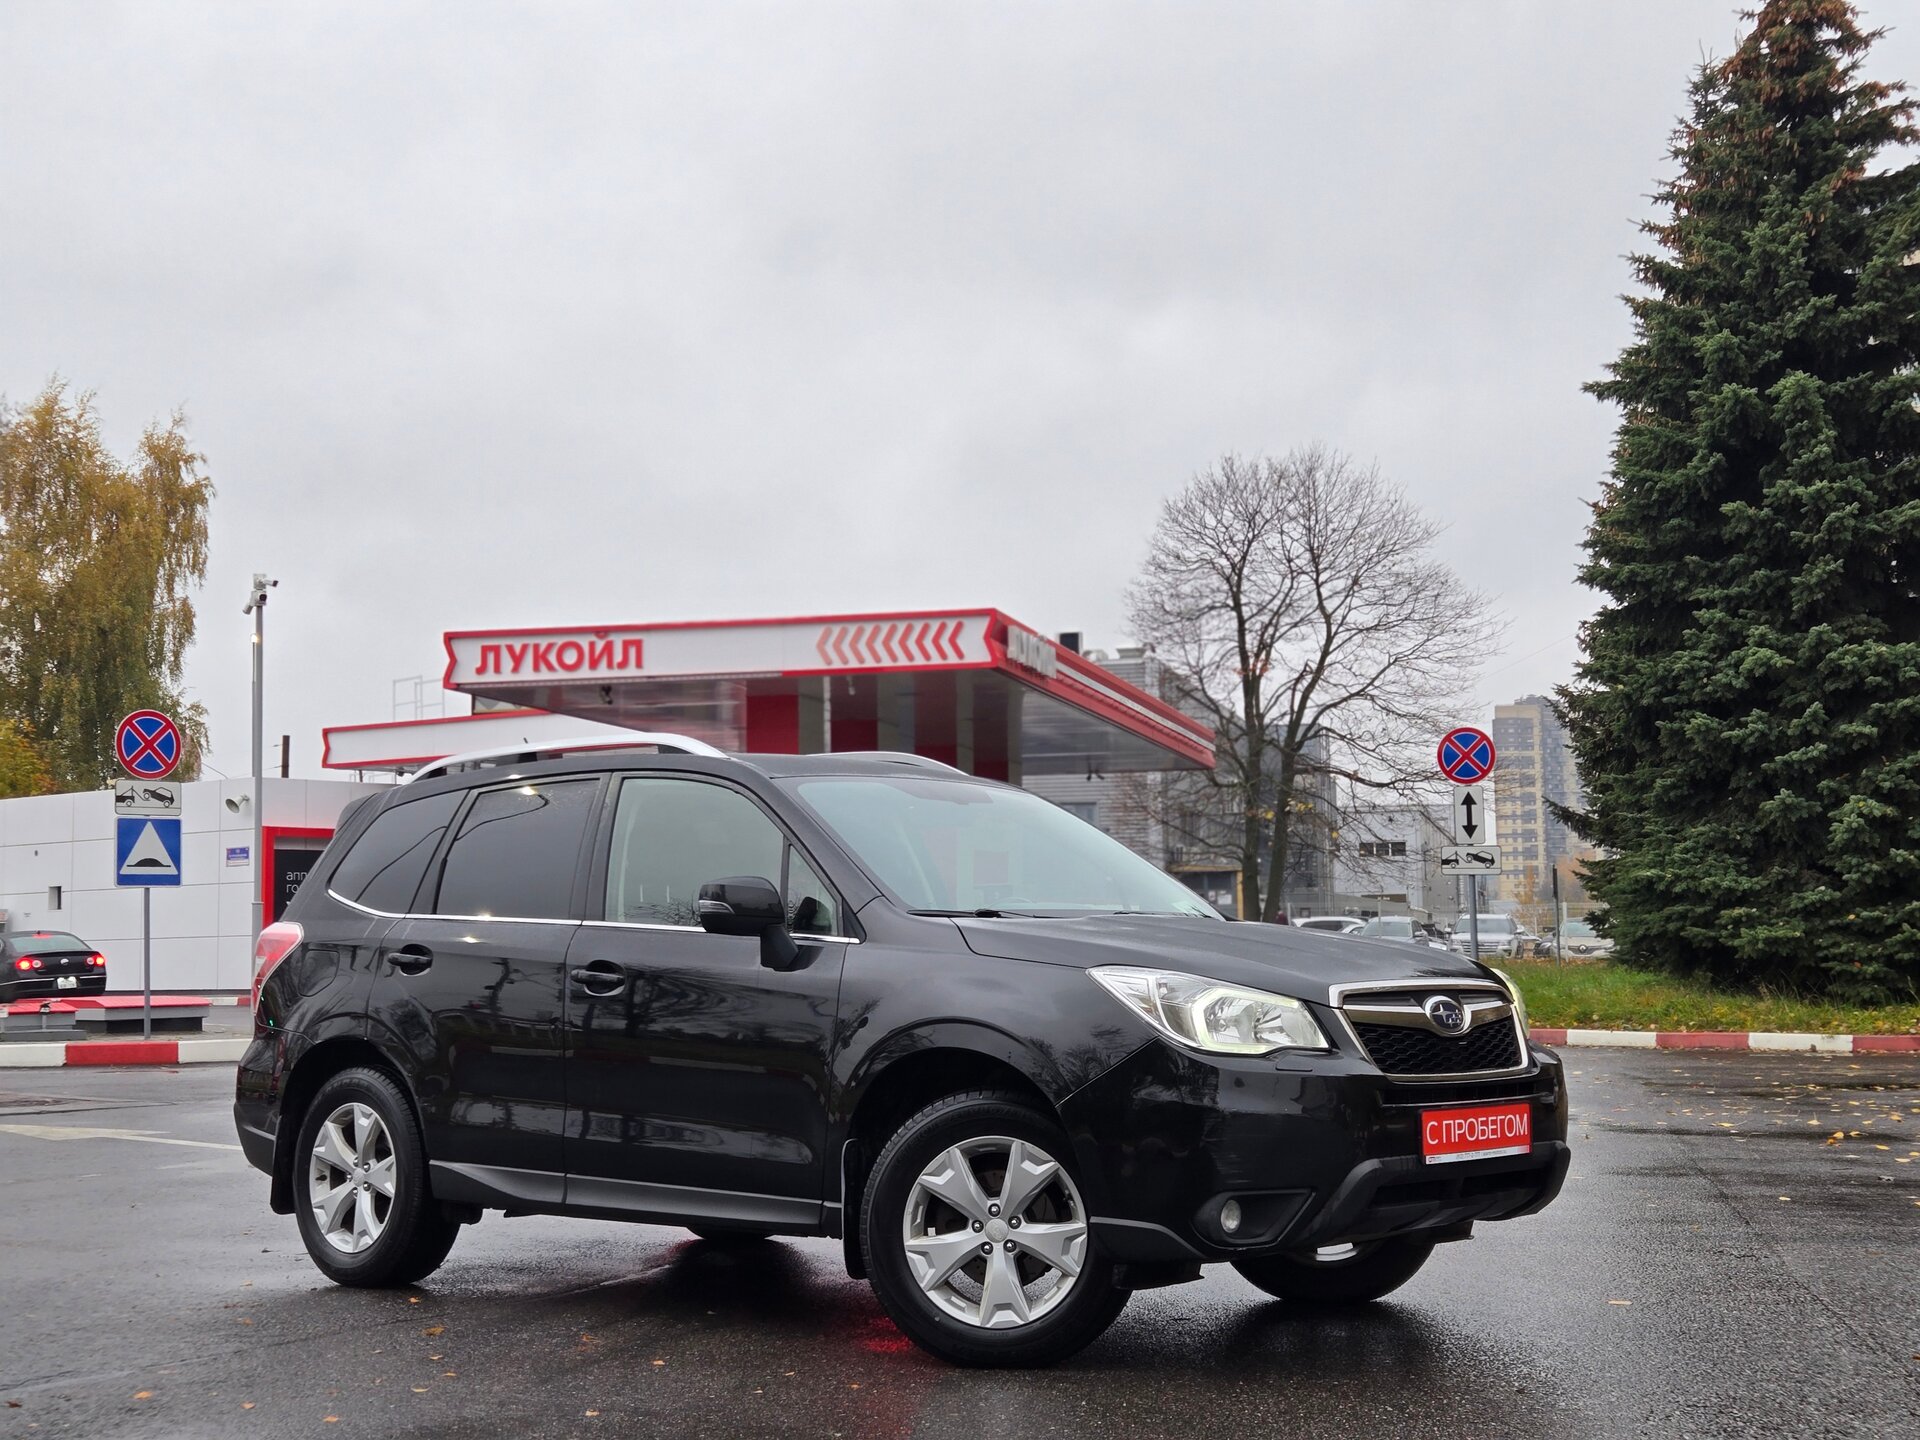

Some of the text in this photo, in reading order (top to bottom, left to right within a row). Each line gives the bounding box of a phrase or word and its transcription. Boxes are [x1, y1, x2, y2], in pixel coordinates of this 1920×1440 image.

[475, 631, 643, 675] ЛУКОЙЛ
[1426, 1113, 1528, 1145] С ПРОБЕГОМ
